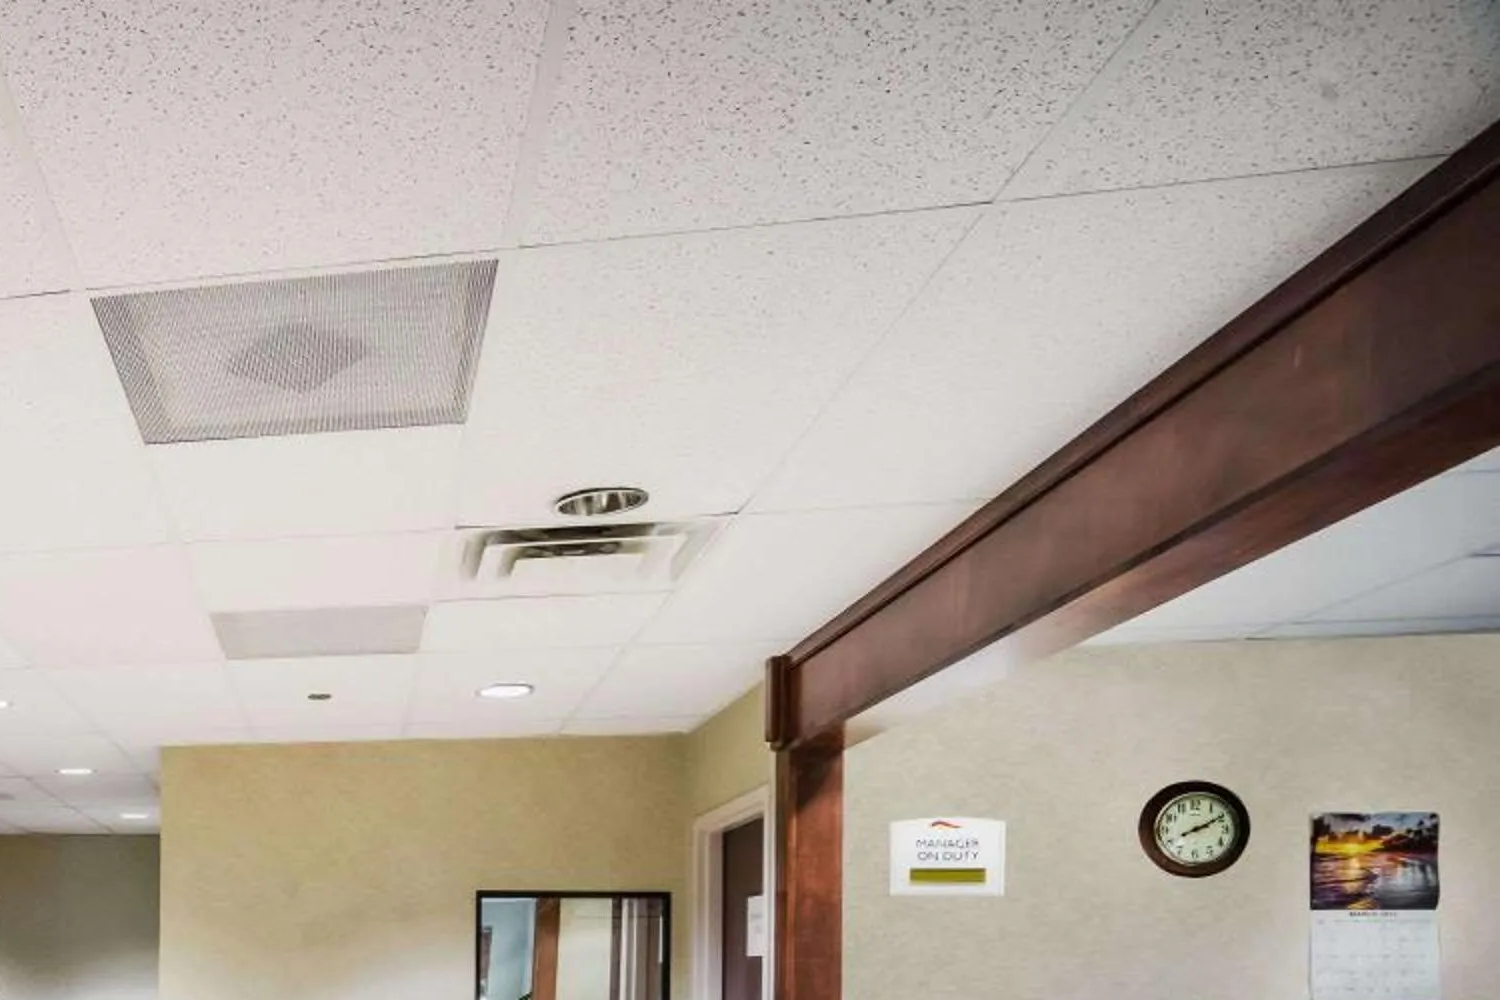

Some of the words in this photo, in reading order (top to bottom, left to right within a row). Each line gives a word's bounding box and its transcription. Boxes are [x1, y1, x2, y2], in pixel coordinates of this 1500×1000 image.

[915, 839, 979, 849] MANAGER
[917, 851, 939, 861] ON
[942, 851, 979, 861] DUTY
